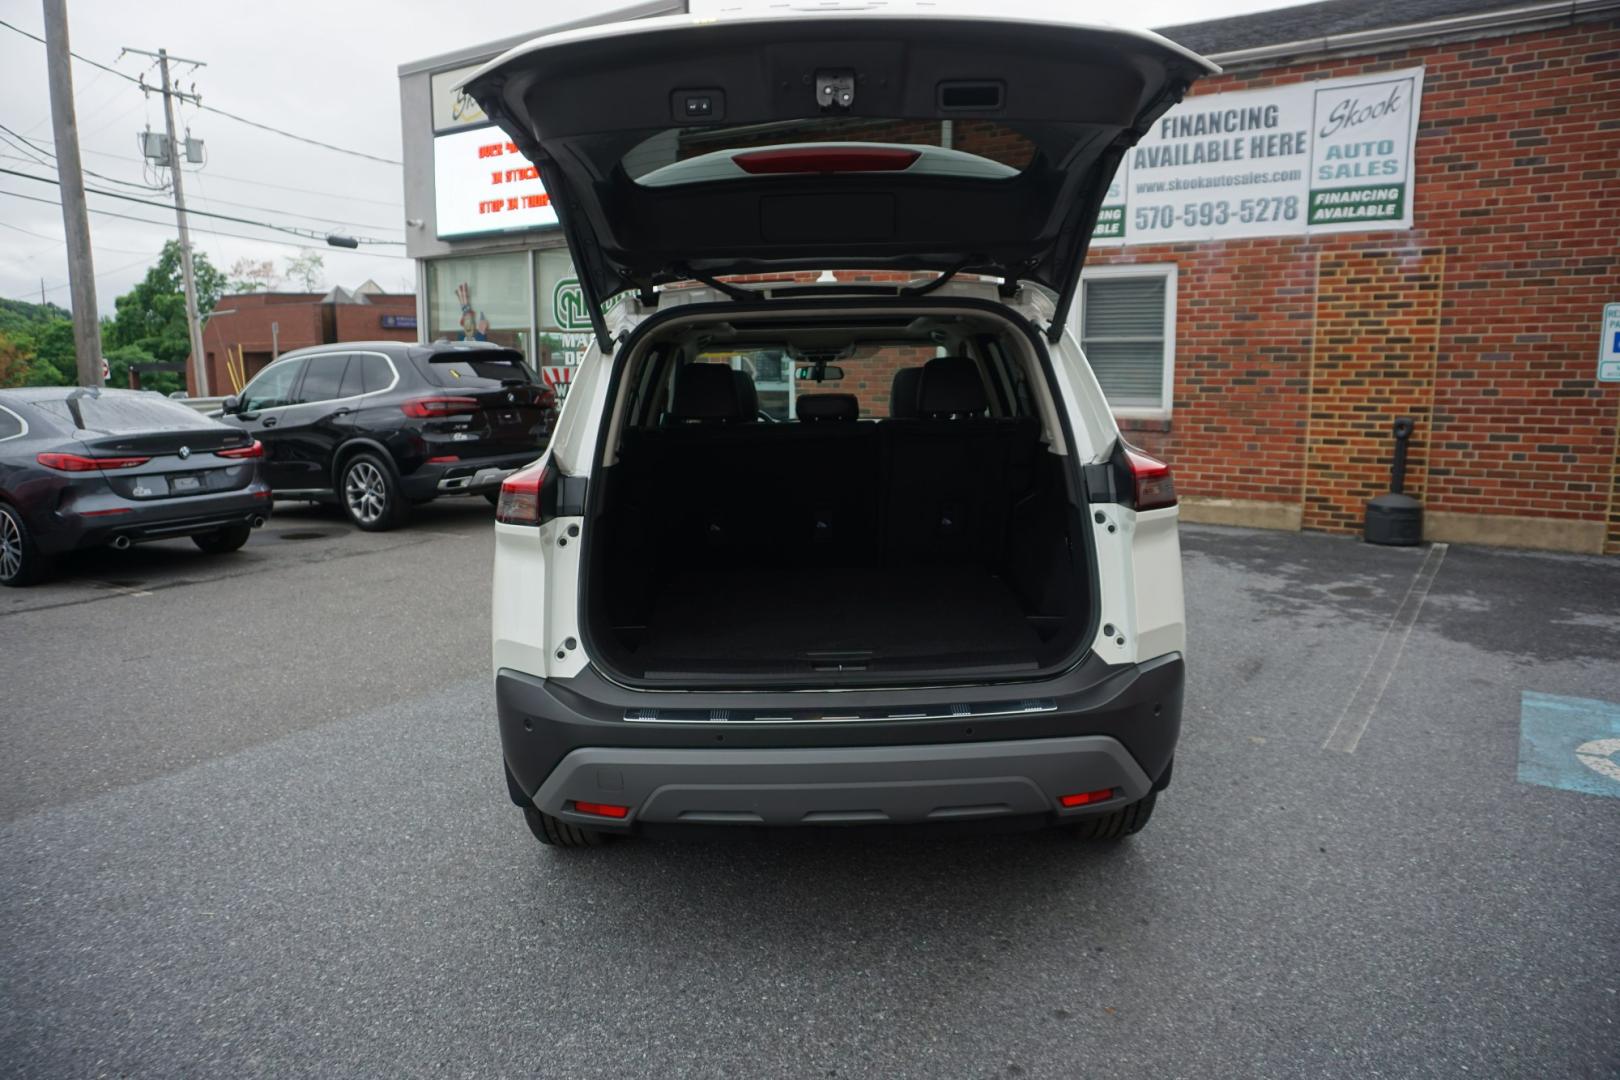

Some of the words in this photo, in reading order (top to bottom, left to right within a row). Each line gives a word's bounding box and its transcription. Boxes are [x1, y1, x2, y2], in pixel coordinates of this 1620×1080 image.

[1161, 104, 1279, 140] FINANCING
[1319, 85, 1401, 138] Skook
[1133, 137, 1245, 170] AVAILABLE
[1250, 130, 1307, 159] HERE
[1325, 139, 1394, 161] AUTO
[1136, 168, 1301, 194] www.skookautosales.com
[1318, 159, 1399, 180] SALES
[1314, 188, 1399, 206] FINANCING
[1135, 195, 1299, 231] 570-593-5278
[1314, 203, 1396, 220] AVAILABLE
